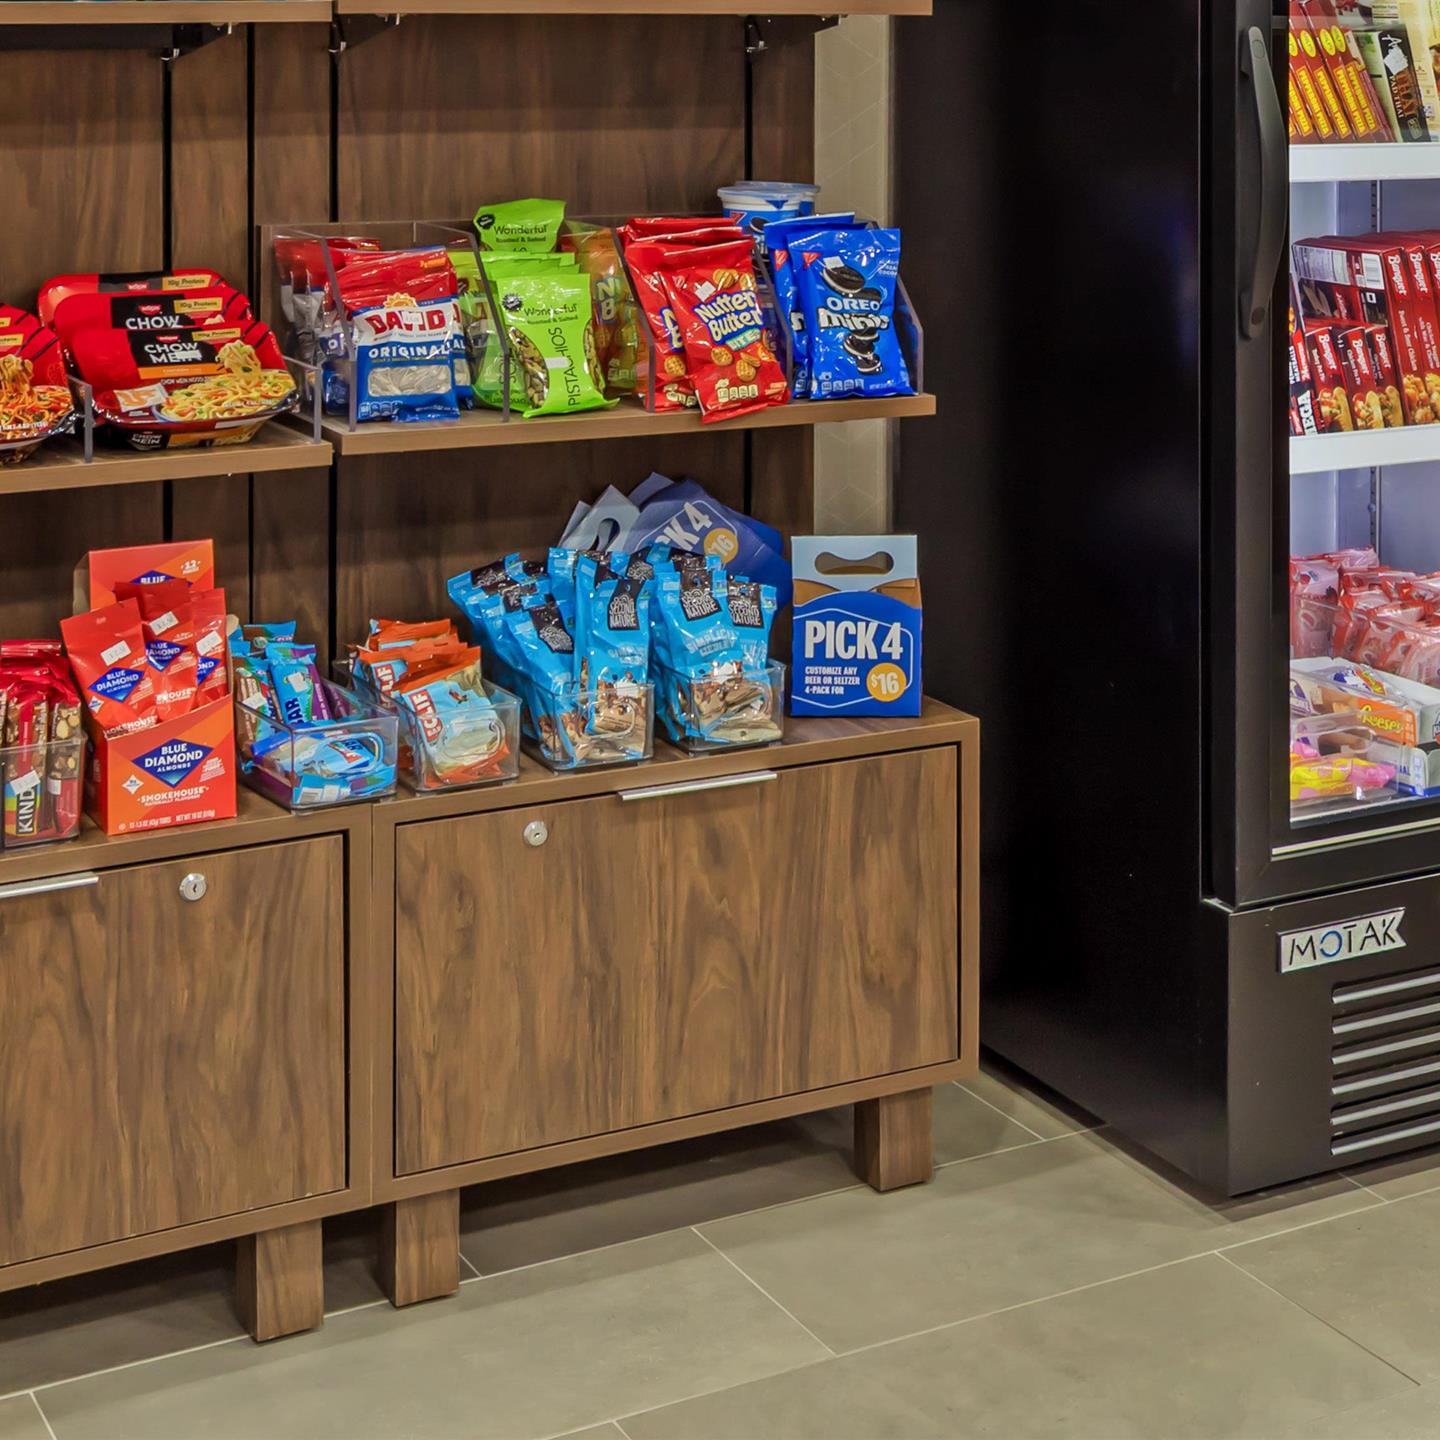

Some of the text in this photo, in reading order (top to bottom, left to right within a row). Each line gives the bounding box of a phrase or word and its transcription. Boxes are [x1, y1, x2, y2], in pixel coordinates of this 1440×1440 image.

[697, 292, 756, 321] Nutter
[827, 297, 880, 310] OREO
[710, 311, 761, 343] Butter
[144, 343, 197, 353] CHOW
[368, 344, 449, 358] ORIGINAL
[804, 620, 903, 660] PICK 4
[805, 666, 857, 675] CUSTOMIZE ANY
[96, 673, 139, 692] DIAMOND
[805, 676, 860, 685] BEER OR SELTZER
[871, 672, 899, 695] $16
[805, 686, 844, 695] 4-PACK FOR
[161, 744, 187, 755] BLUE
[145, 750, 203, 767] DIAMOND
[1288, 916, 1398, 966] MOTAK
